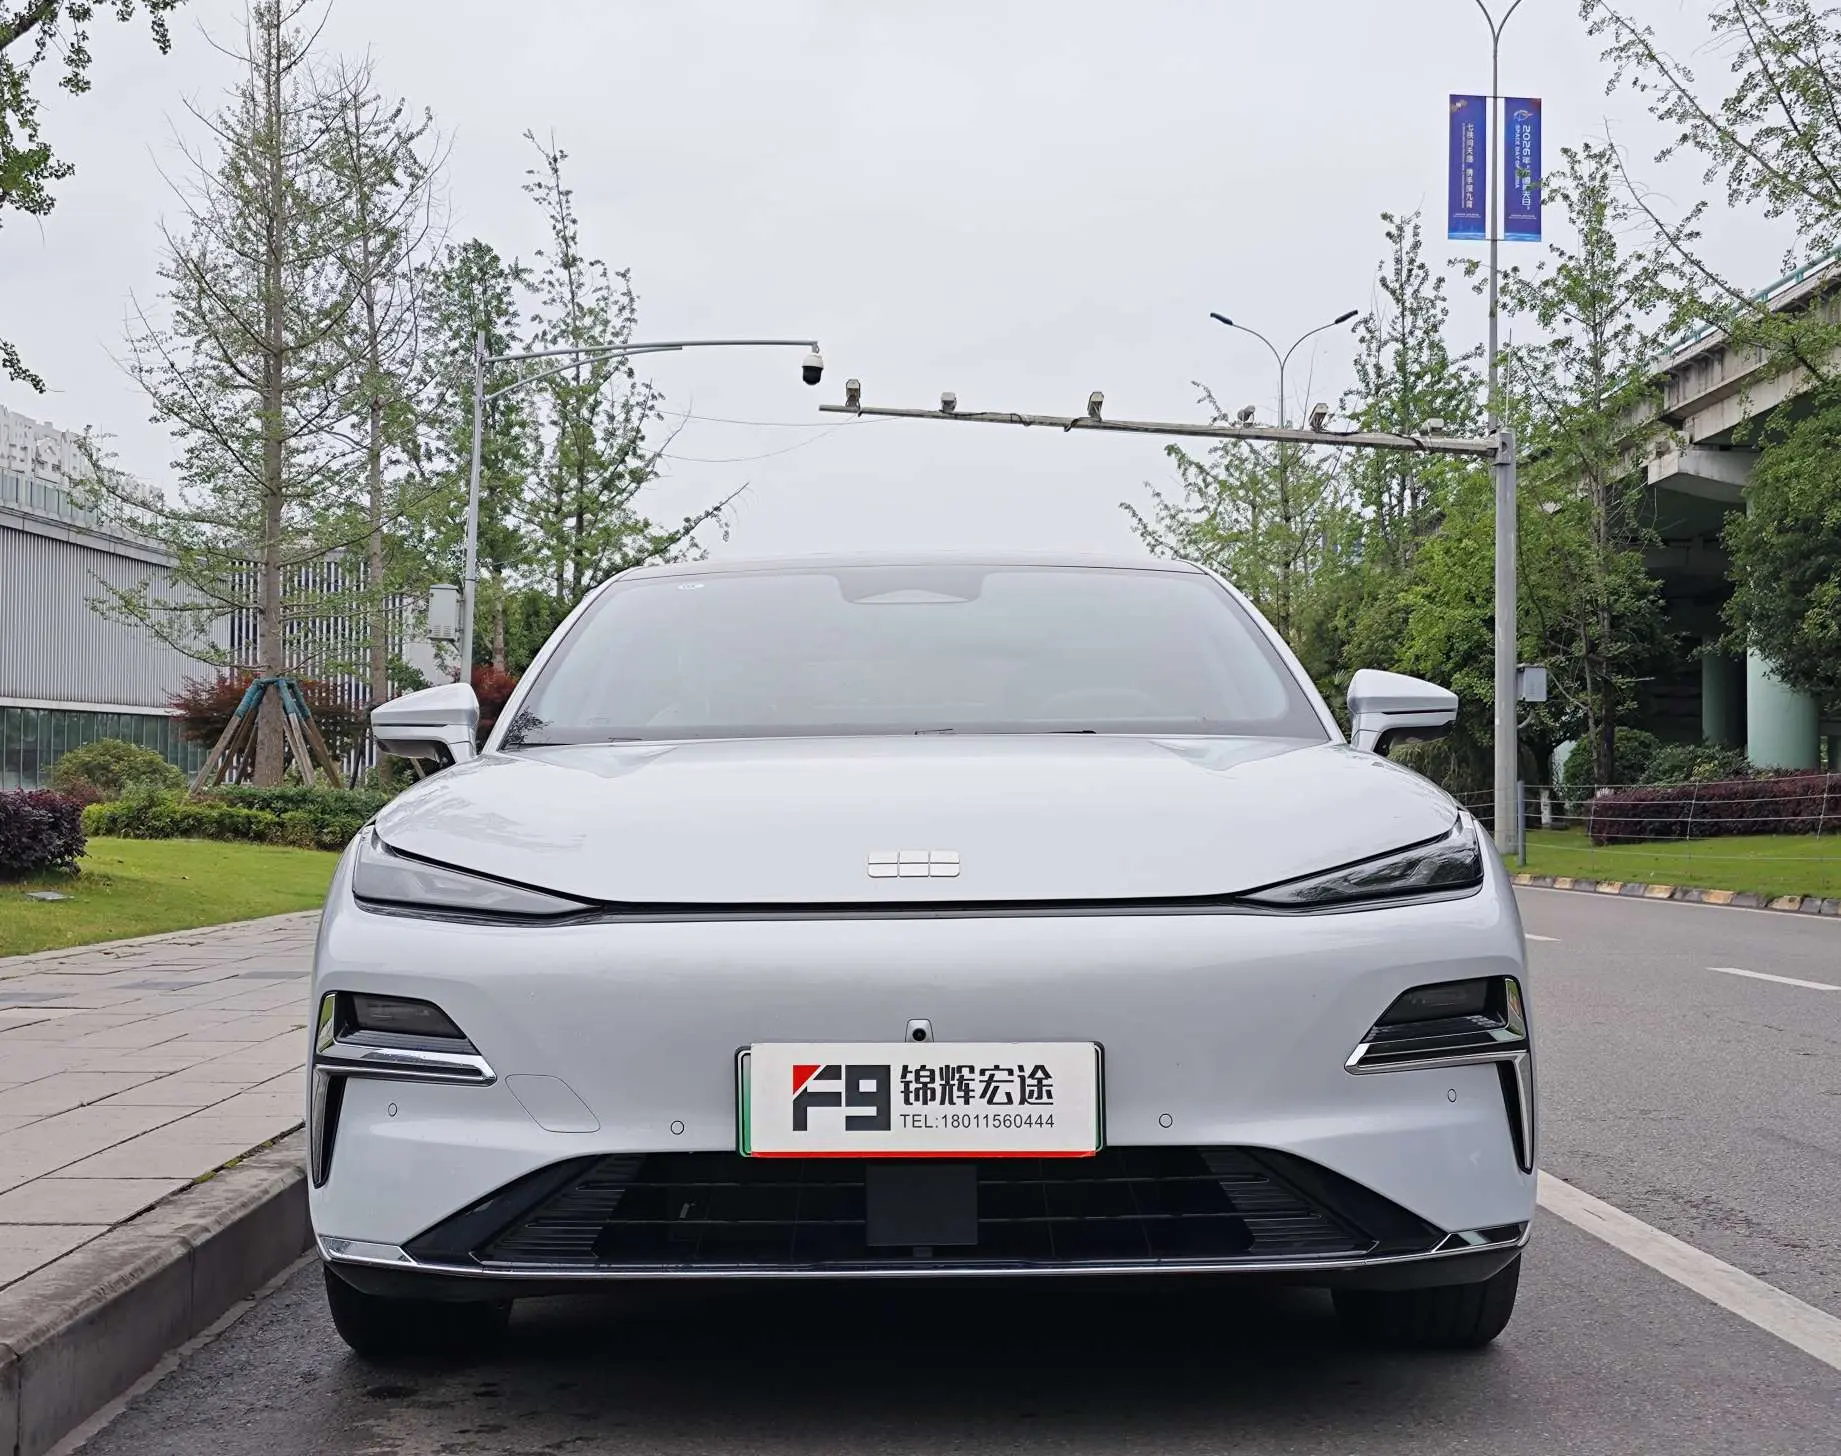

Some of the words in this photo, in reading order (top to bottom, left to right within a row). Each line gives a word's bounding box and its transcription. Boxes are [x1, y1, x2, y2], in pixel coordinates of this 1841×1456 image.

[900, 1064, 1054, 1106] 锦辉宏途
[900, 1113, 1055, 1129] TEL:18011560444
